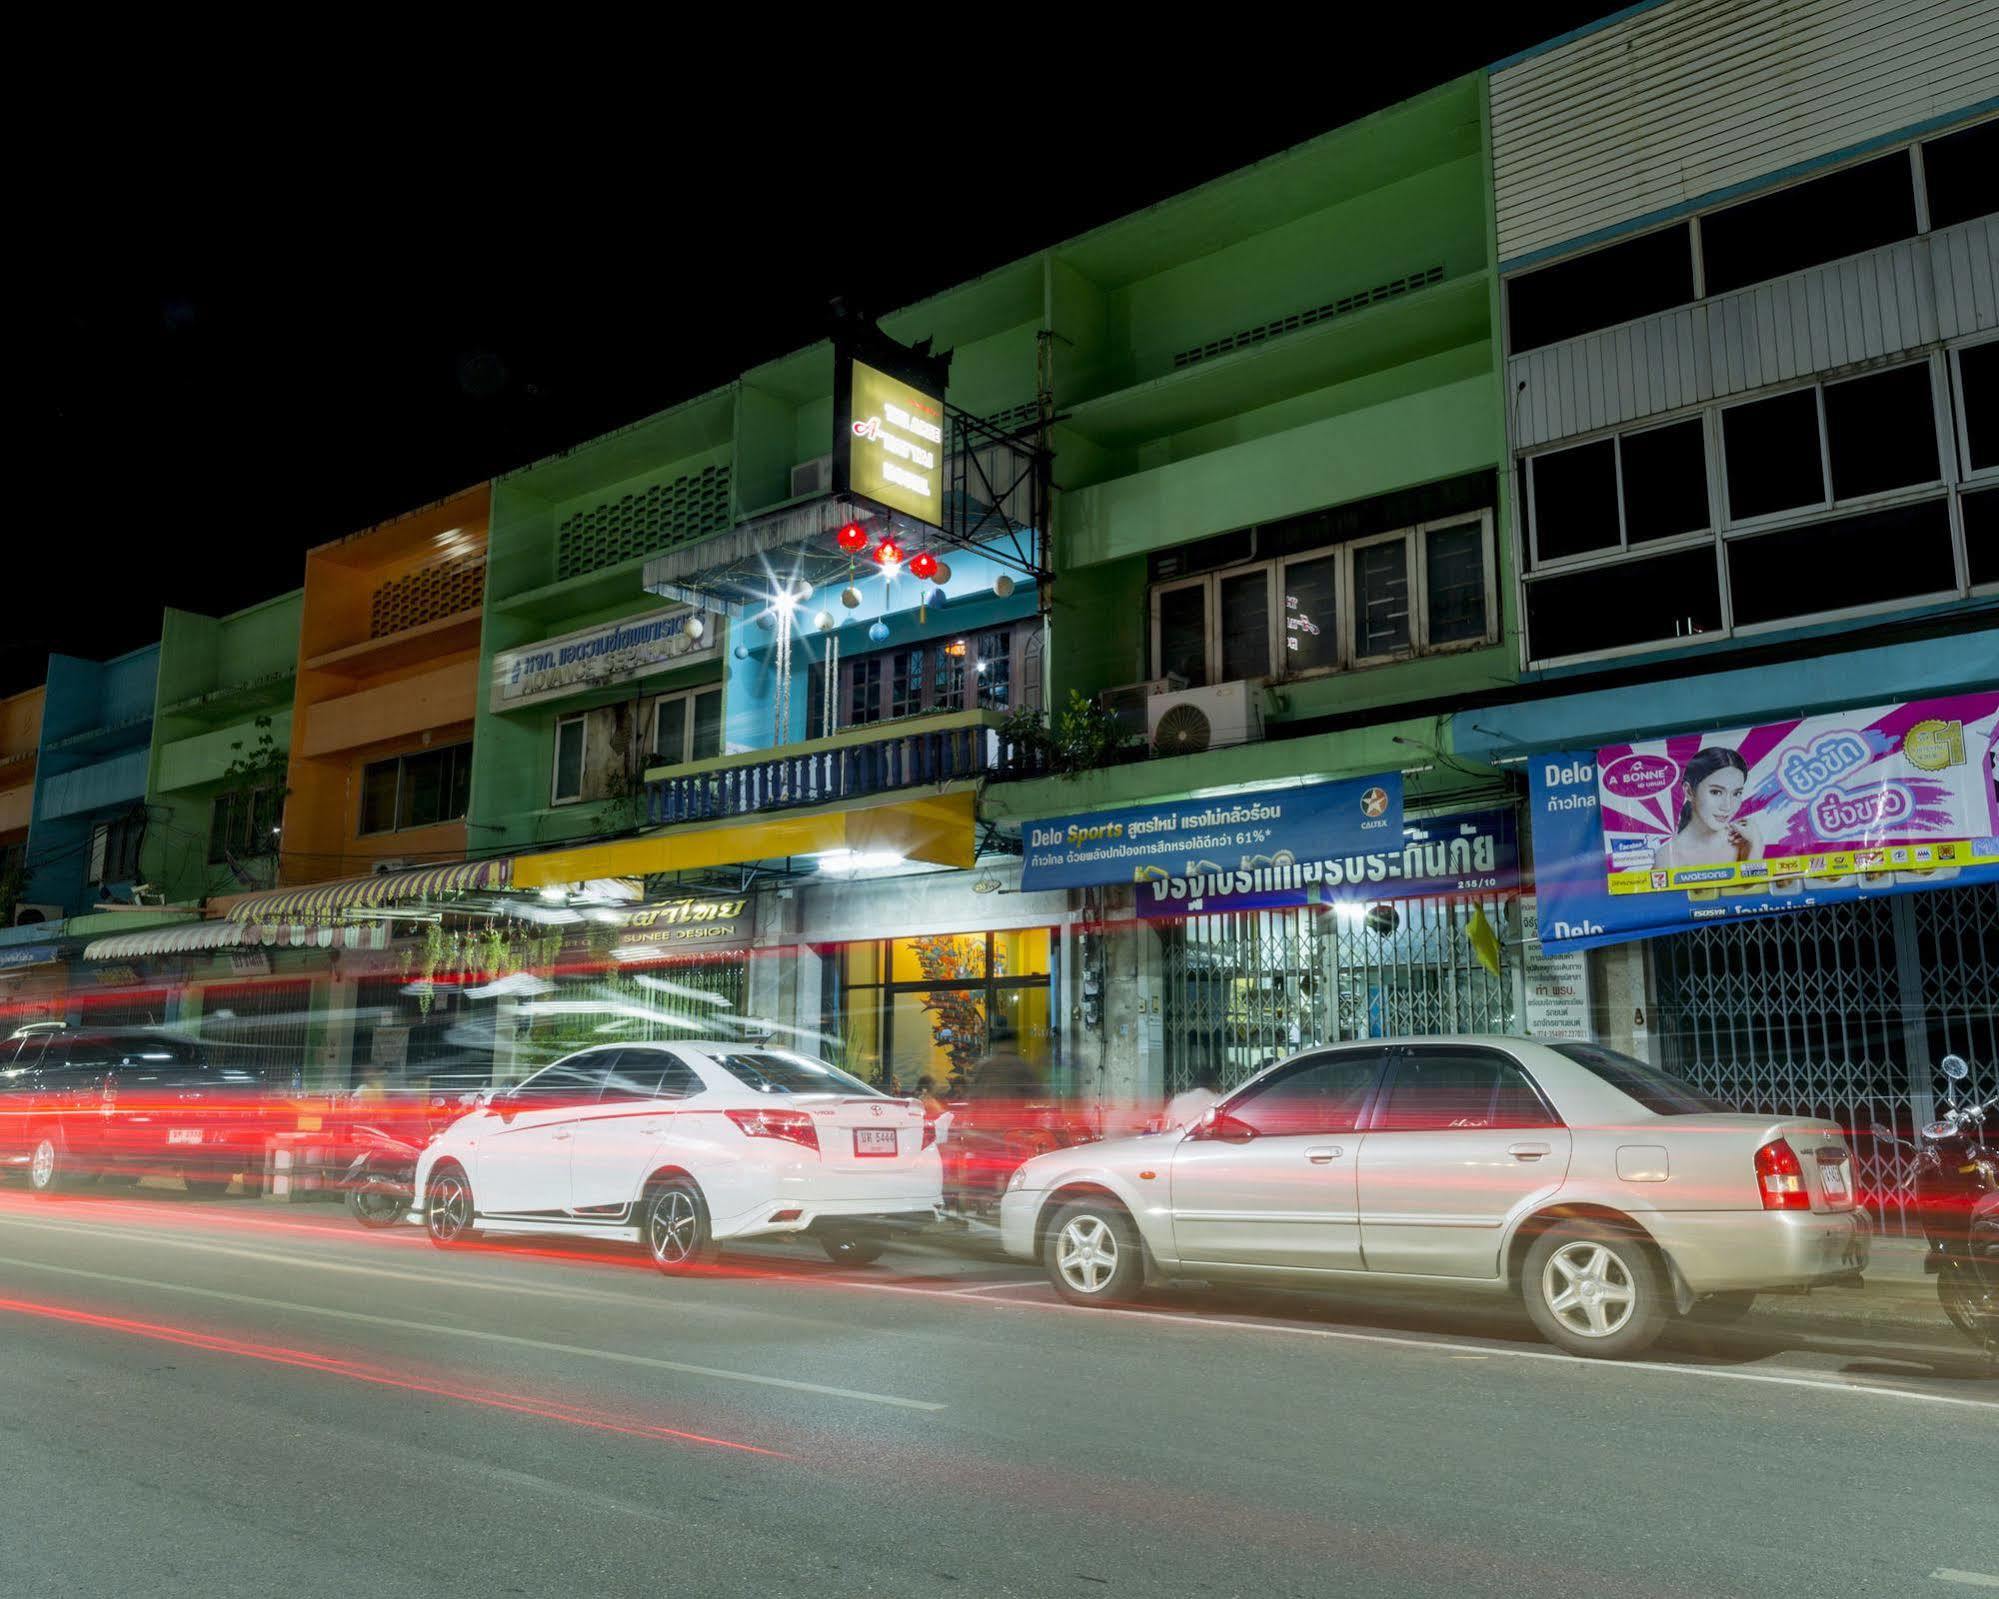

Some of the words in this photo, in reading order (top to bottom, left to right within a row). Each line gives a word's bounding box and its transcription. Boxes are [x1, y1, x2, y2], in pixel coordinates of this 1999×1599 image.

[1545, 762, 1592, 787] Delo
[1609, 776, 1618, 785] A
[1547, 794, 1597, 812] ก้าวไกล
[1031, 827, 1063, 847] Delo
[1067, 822, 1123, 848] Sports
[1128, 814, 1177, 839] สูตรใหม่
[1181, 803, 1281, 829] แรงไม่กลัวร้อน
[1361, 819, 1388, 829] CALTEX
[1031, 853, 1064, 867] ก้าวไกล
[1680, 871, 1728, 882] watsons
[623, 930, 671, 943] SUNEE
